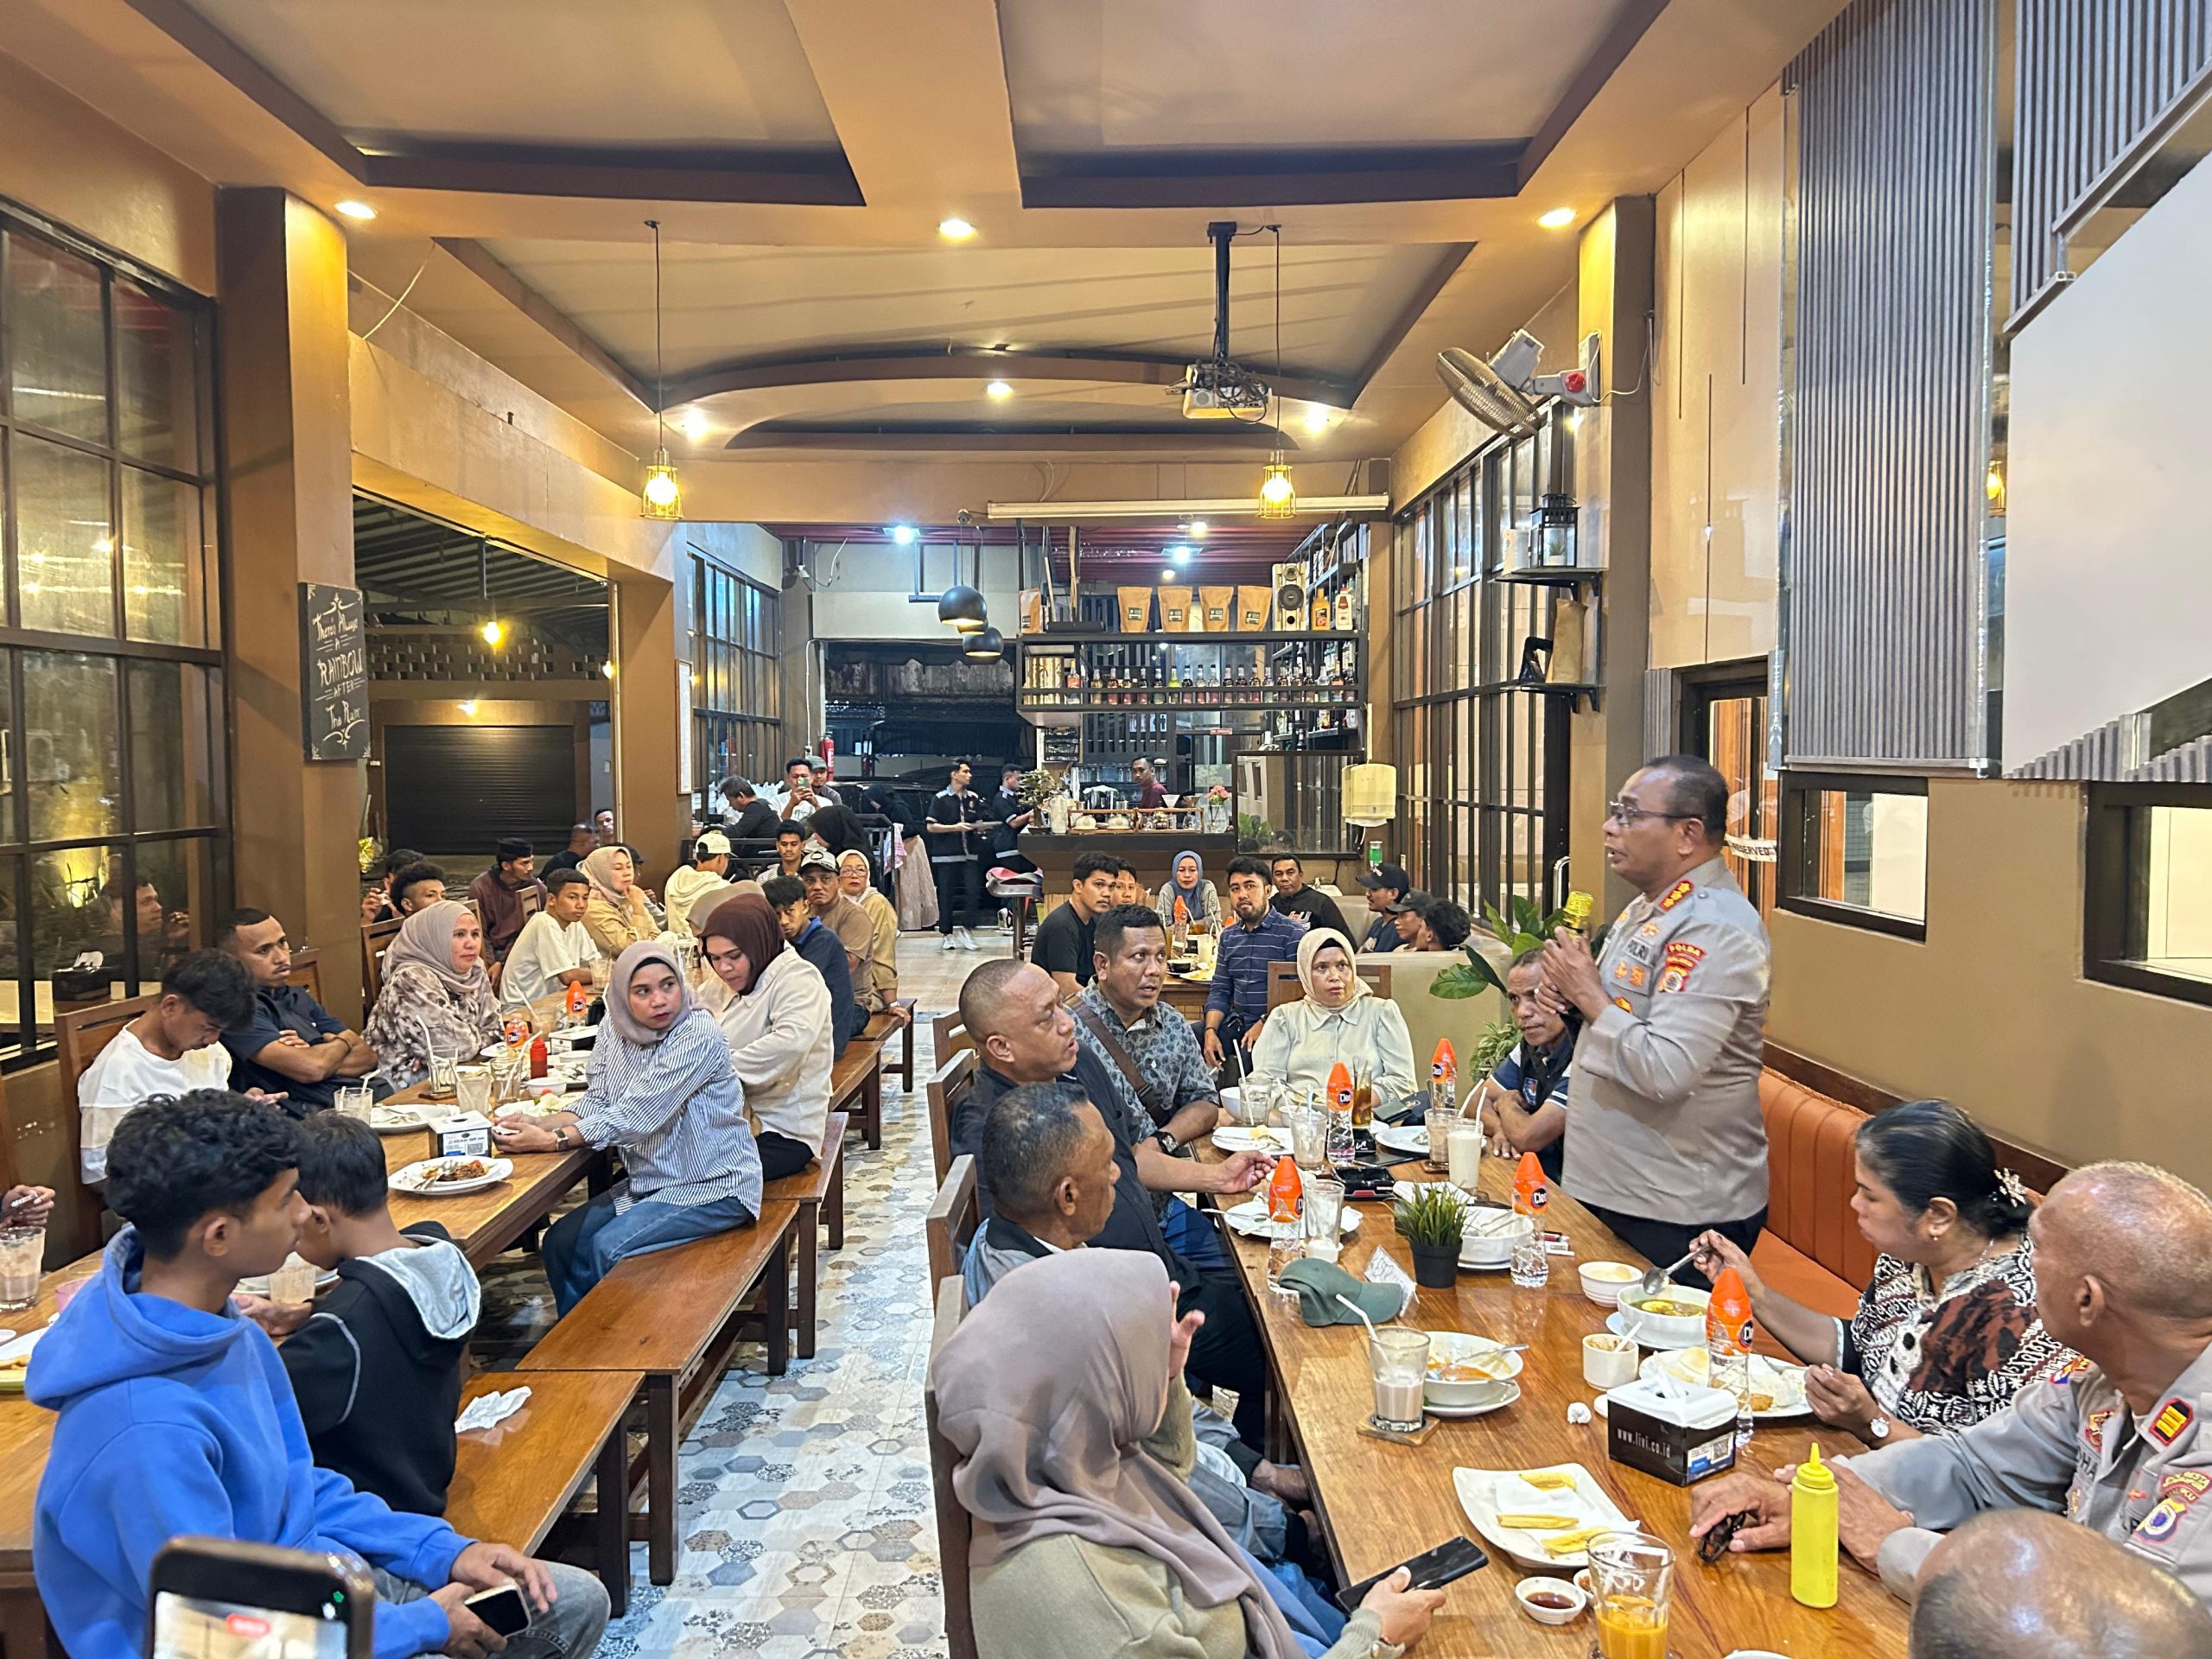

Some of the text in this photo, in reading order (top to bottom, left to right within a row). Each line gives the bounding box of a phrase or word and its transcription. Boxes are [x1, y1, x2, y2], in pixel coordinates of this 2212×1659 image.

[334, 638, 340, 651] A
[317, 648, 363, 687] RAINBOW
[334, 680, 354, 697] AFTER
[1617, 1428, 1670, 1459] www.livi.co.id
